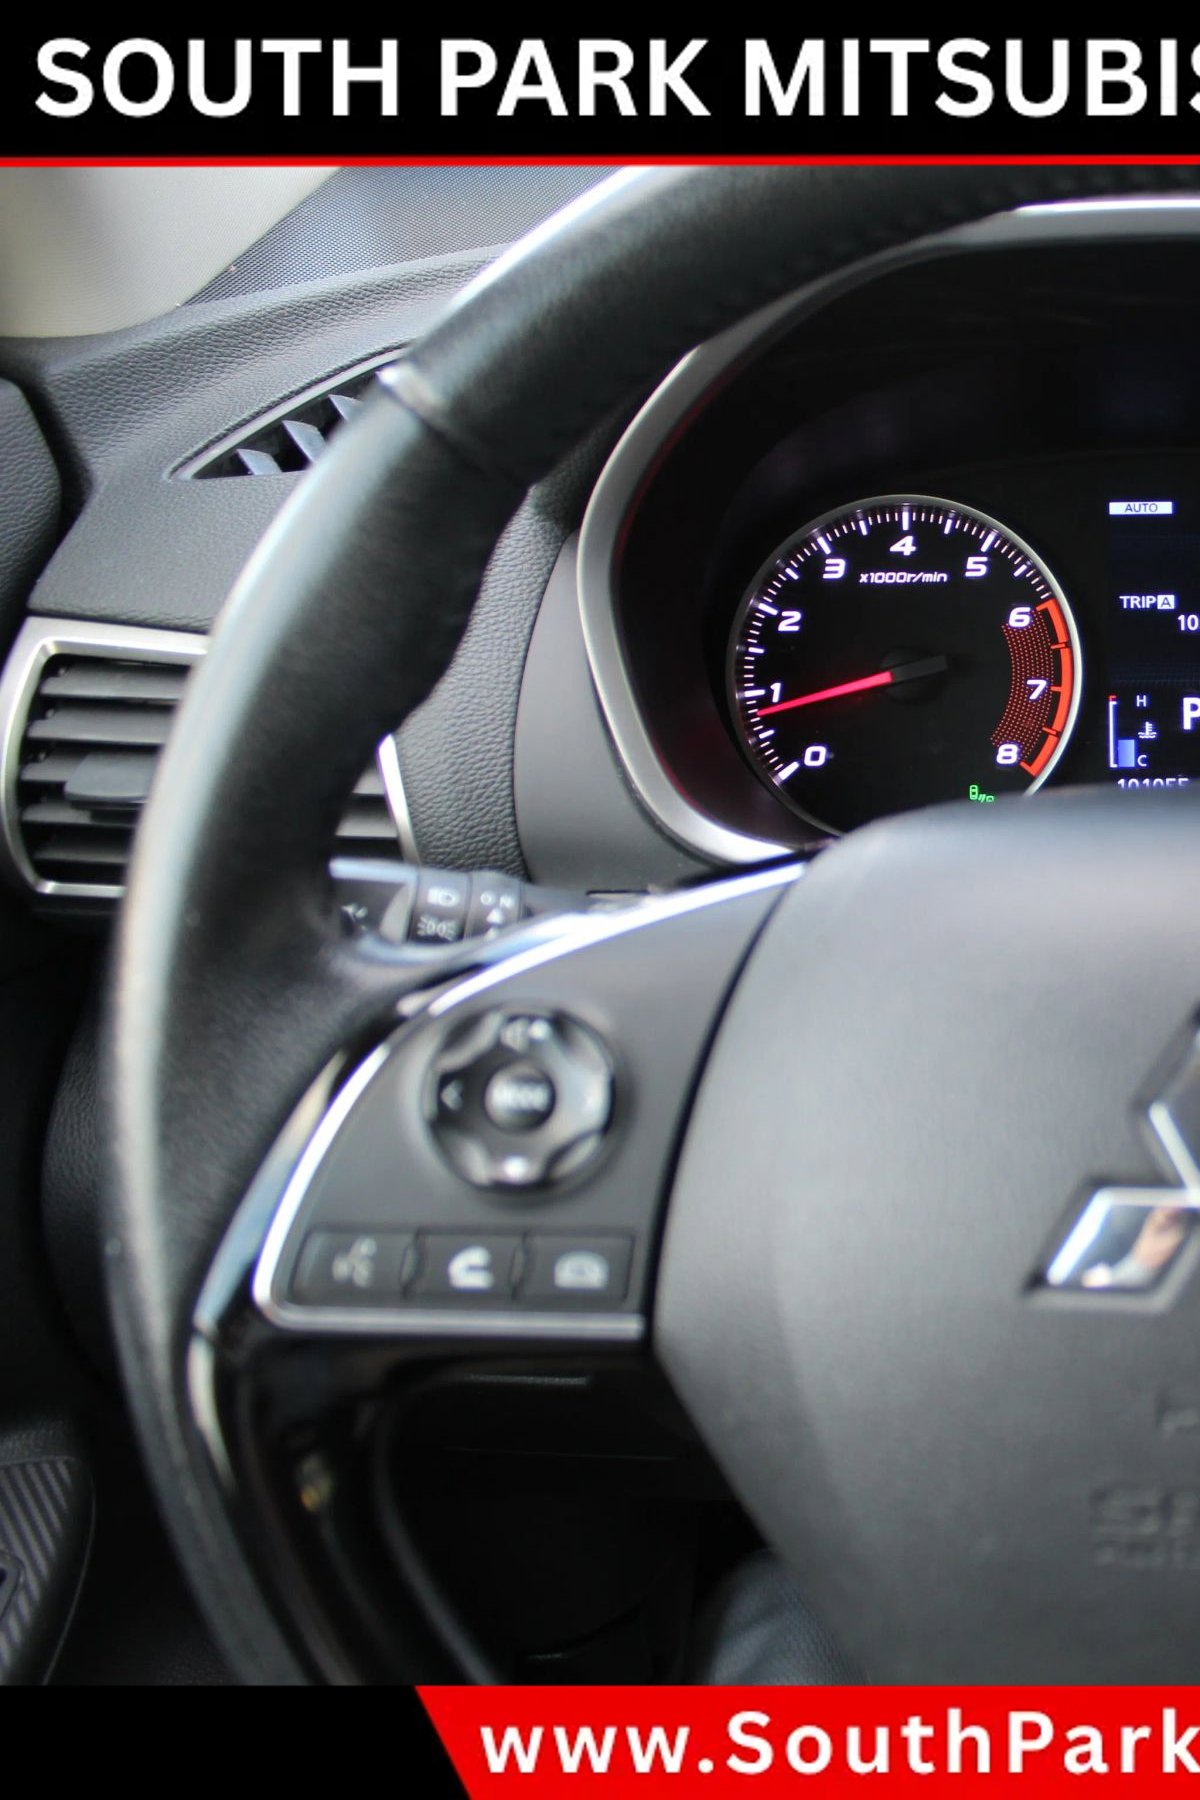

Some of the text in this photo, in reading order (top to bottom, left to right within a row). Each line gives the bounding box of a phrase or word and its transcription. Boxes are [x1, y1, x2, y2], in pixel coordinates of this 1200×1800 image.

[1123, 502, 1159, 514] AUTO
[889, 535, 917, 556] 4
[822, 558, 847, 579] 3
[859, 571, 948, 584] x1000r/min
[964, 556, 989, 578] 5
[1119, 595, 1157, 609] TRIP
[777, 610, 802, 632] 2
[1007, 606, 1032, 628] 6
[769, 682, 782, 703] 1
[1026, 679, 1048, 701] 7
[1136, 694, 1148, 707] H
[803, 745, 827, 767] 0
[996, 743, 1020, 765] 8
[1137, 754, 1147, 767] C
